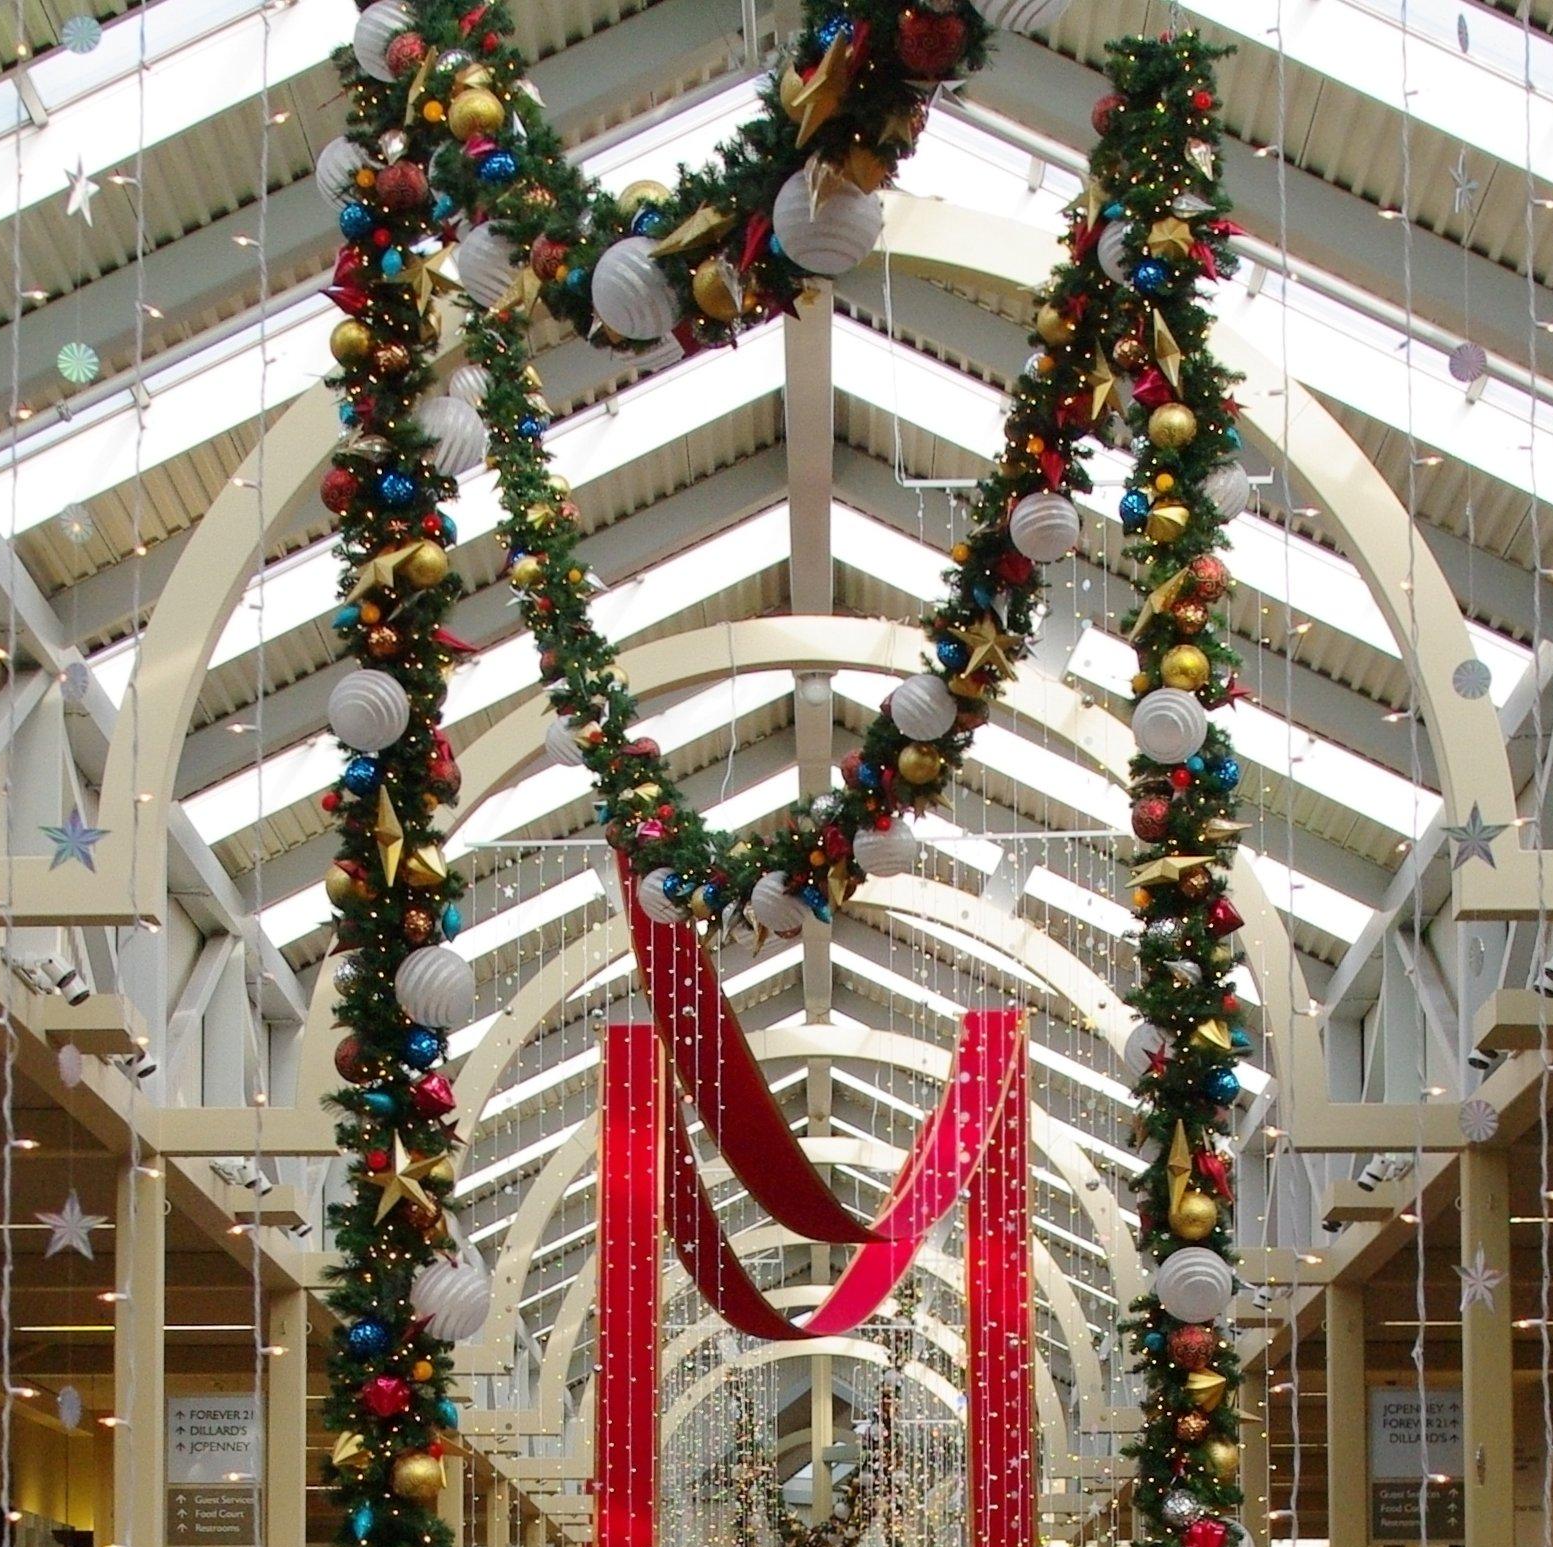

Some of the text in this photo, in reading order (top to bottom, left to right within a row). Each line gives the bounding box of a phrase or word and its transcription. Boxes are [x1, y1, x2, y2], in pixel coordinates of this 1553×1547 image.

[189, 1410, 254, 1420] FOREVER 21
[1383, 1403, 1444, 1417] JCPENEY
[1383, 1419, 1434, 1429] FOREVR
[189, 1425, 248, 1436] DILLARD'S
[1389, 1432, 1448, 1443] DILLAD'S
[189, 1441, 251, 1454] JCPENNEY
[194, 1509, 245, 1518] Food Court
[194, 1523, 240, 1532] Restrooms
